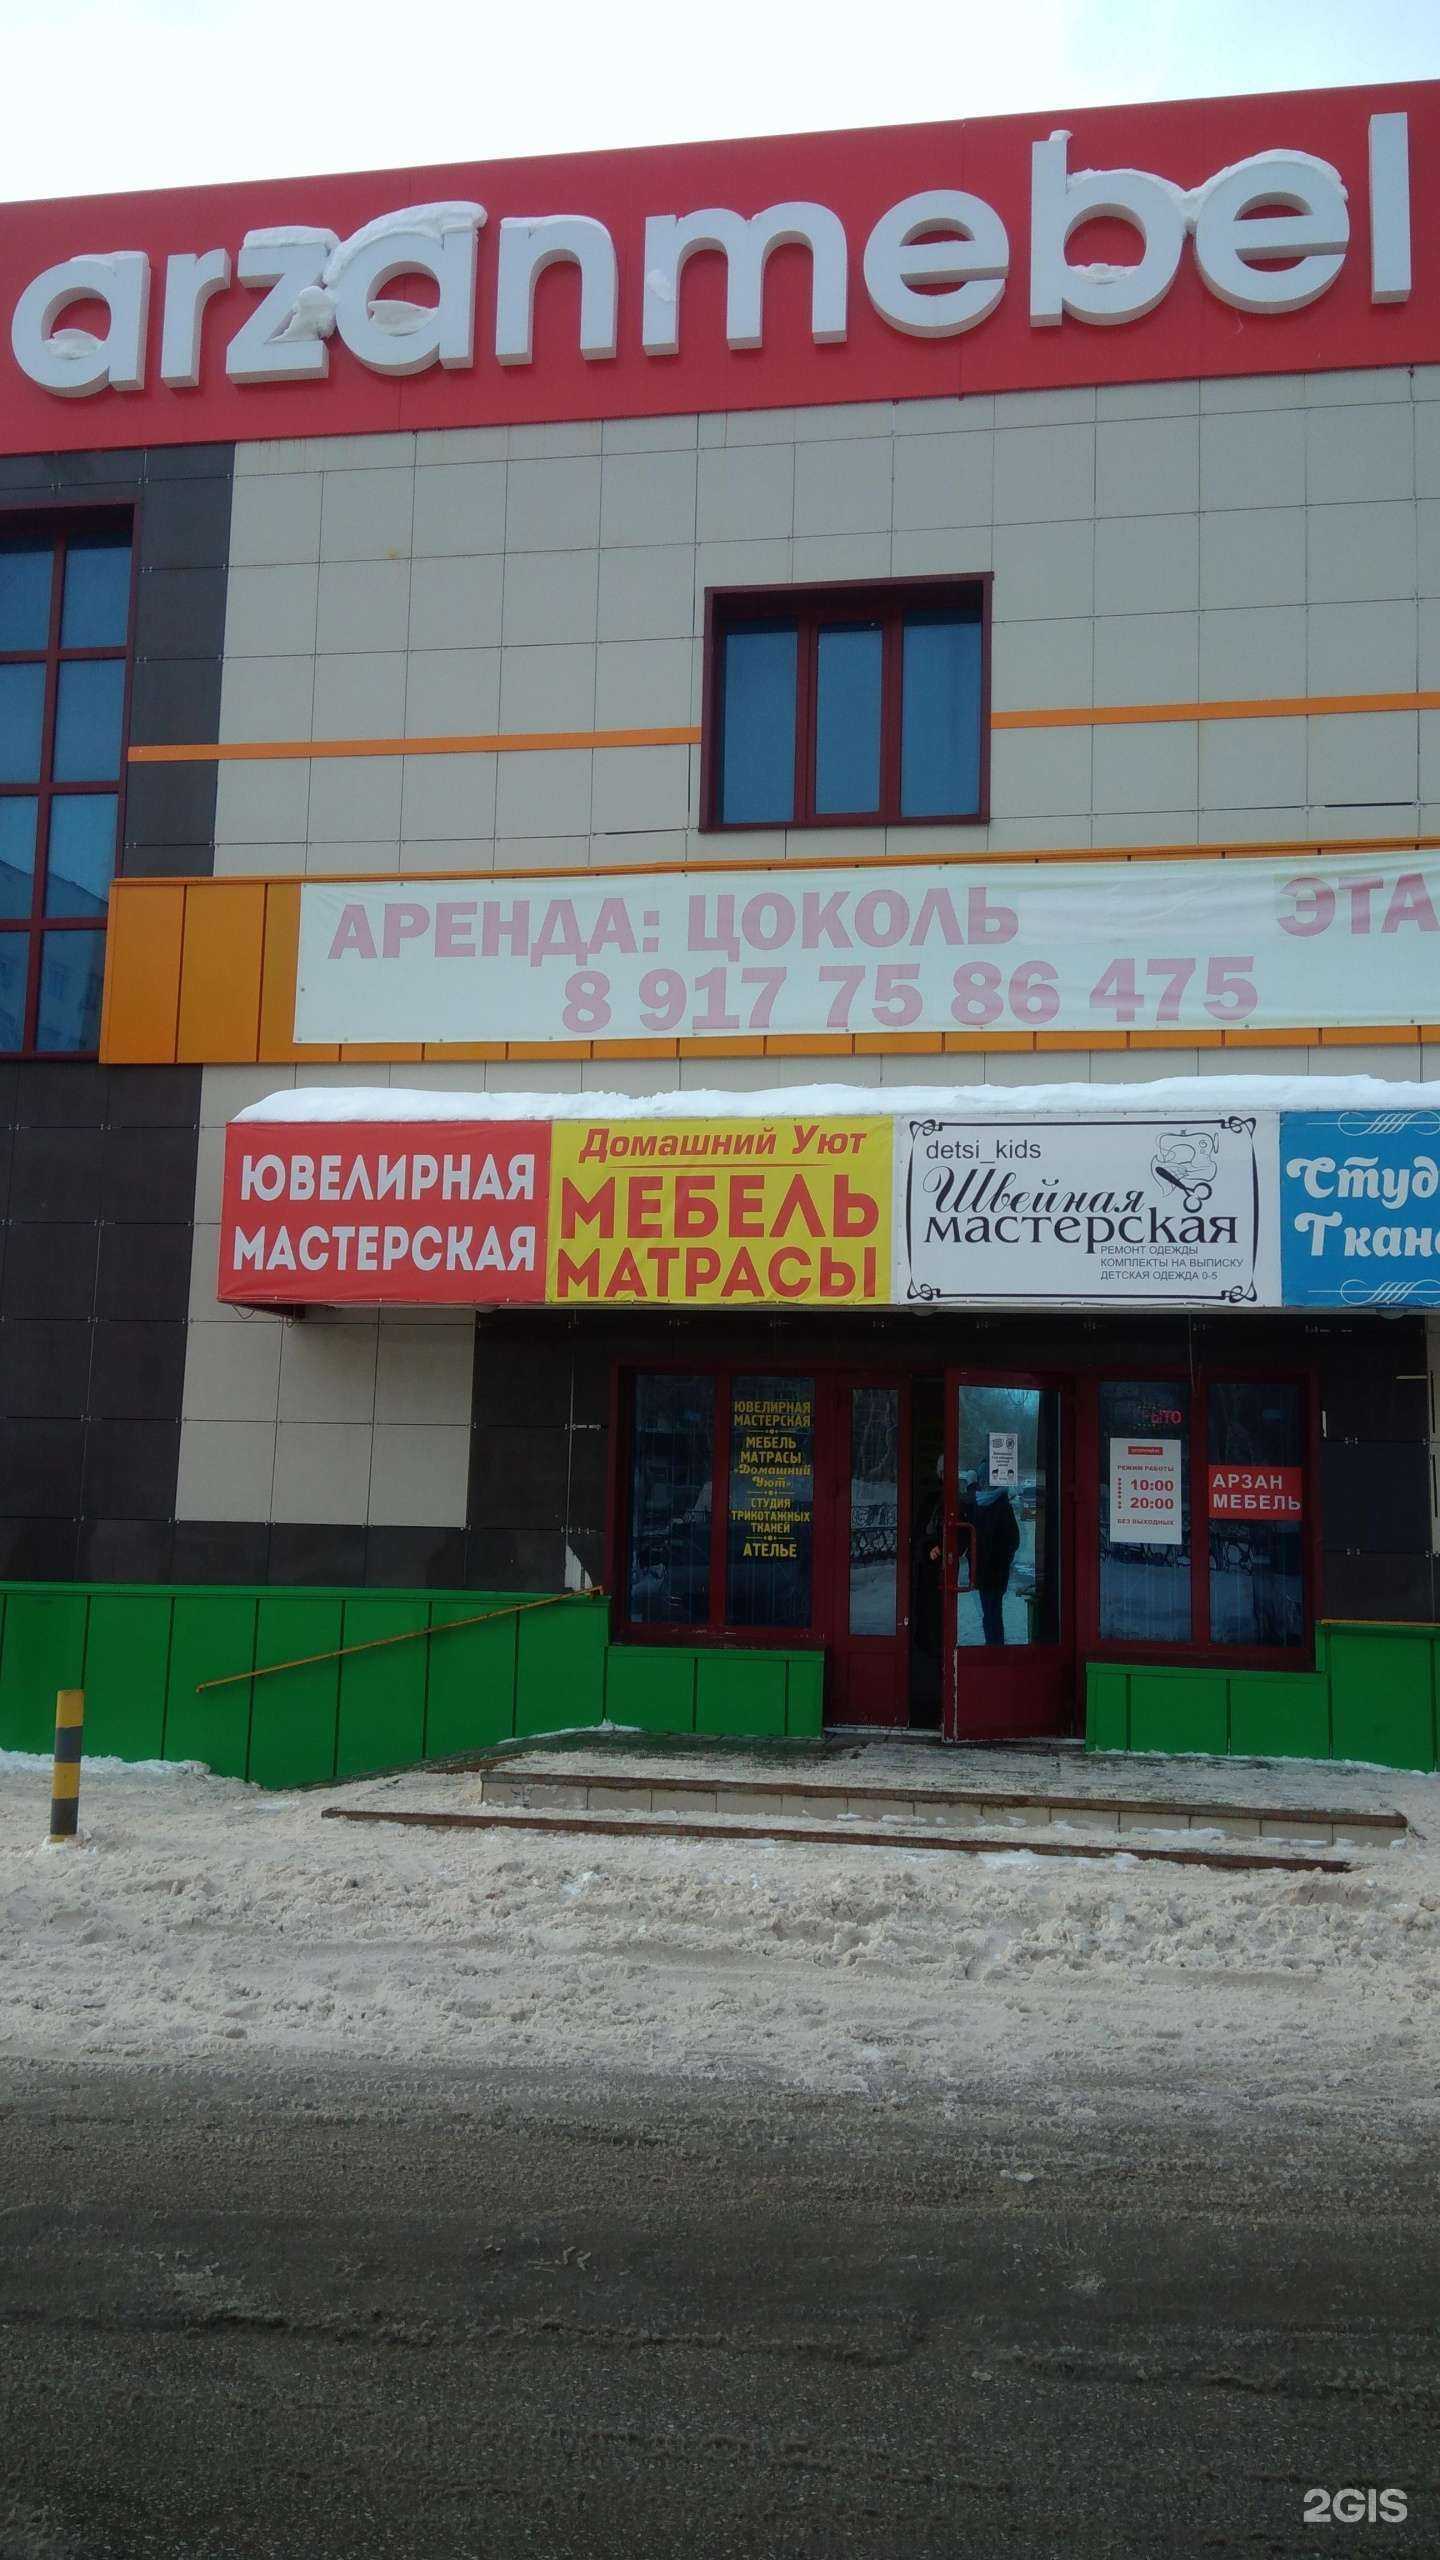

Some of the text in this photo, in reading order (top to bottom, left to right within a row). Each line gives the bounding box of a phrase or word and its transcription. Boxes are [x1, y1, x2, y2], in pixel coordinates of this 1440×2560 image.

[11, 111, 1411, 397] arzanmebel
[327, 897, 661, 968] АРЕНДА:
[687, 887, 1020, 962] ЦОКОЛЬ
[562, 956, 1258, 1033] 8 917 75 86 475
[578, 1125, 867, 1164] Домашний Уют
[926, 1139, 1042, 1164] detsi_kids
[240, 1153, 536, 1201] ЮВЕЛИРНАЯ
[922, 1165, 1146, 1214] Швейная
[561, 1174, 879, 1239] МЕБЕЛЬ
[923, 1207, 1239, 1255] мастерская
[232, 1225, 536, 1271] МАСТЕРСКАЯ
[1100, 1245, 1199, 1256] РЕМОНТ ОДЕЖДЫ
[1100, 1258, 1244, 1268] КОМПЛЕКТЫ НА ВЫПИСКУ
[556, 1246, 877, 1298] МАТРАСЫ
[1100, 1271, 1219, 1281] ДЕТСКАЯ ОДЕЖДА 0-5
[734, 1401, 811, 1414] ЮВЕЛИРНАЯ
[734, 1414, 811, 1426] МАСТЕРСКАЯ
[745, 1436, 797, 1449] МЕБЕЛЬ
[740, 1451, 802, 1464] МАТРАСЫ
[1130, 1479, 1174, 1492] 10:00
[1212, 1473, 1282, 1489] АРЗАН
[751, 1498, 791, 1510] СТУДИЯ
[1130, 1497, 1174, 1510] 20:00
[1212, 1494, 1301, 1510] МЕБЕЛЬ
[731, 1510, 811, 1522] ТРИКОТАЖНЫХ
[751, 1522, 790, 1534] ТКАНЕЙ
[743, 1543, 797, 1558] АТЕЛЬЕ
